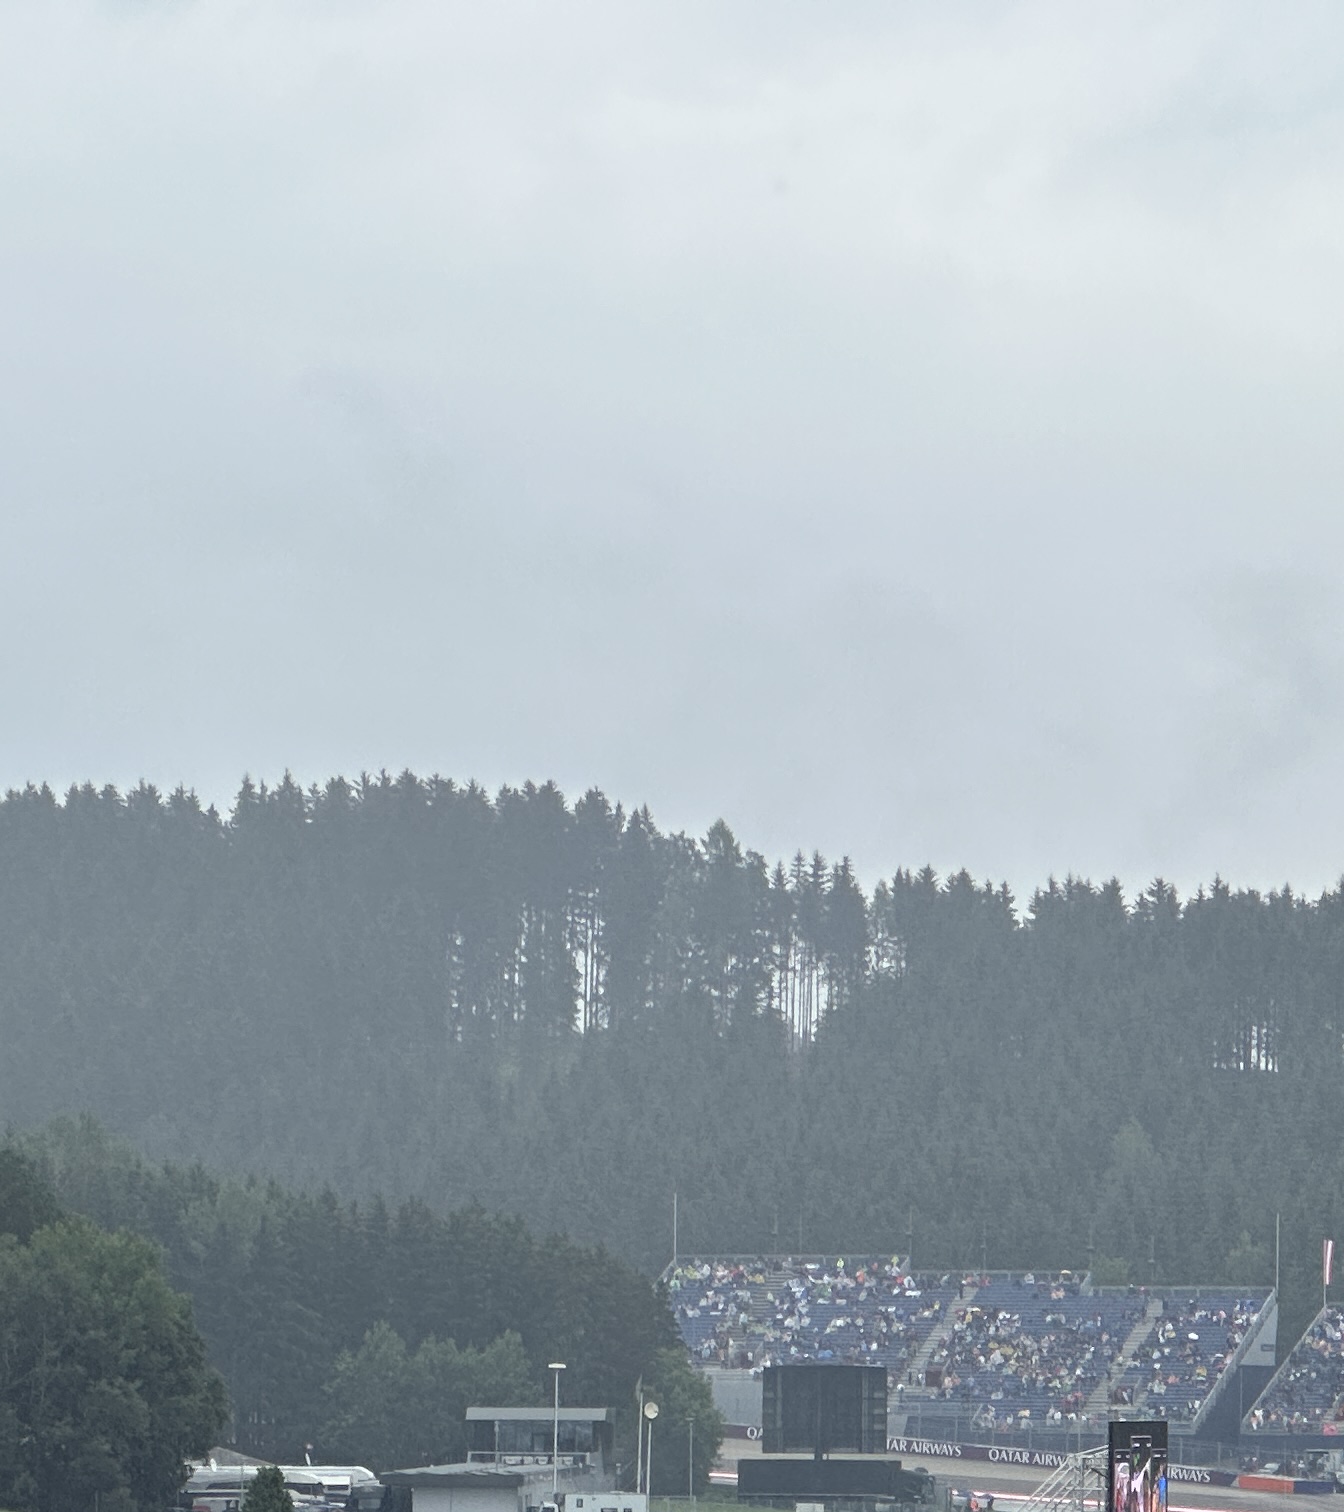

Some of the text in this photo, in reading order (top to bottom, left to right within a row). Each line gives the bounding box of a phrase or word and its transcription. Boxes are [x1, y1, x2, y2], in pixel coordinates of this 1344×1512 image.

[910, 1441, 962, 1457] AIRWAYS
[988, 1448, 1030, 1465] QATAR
[1167, 1467, 1211, 1483] IRWAYS
